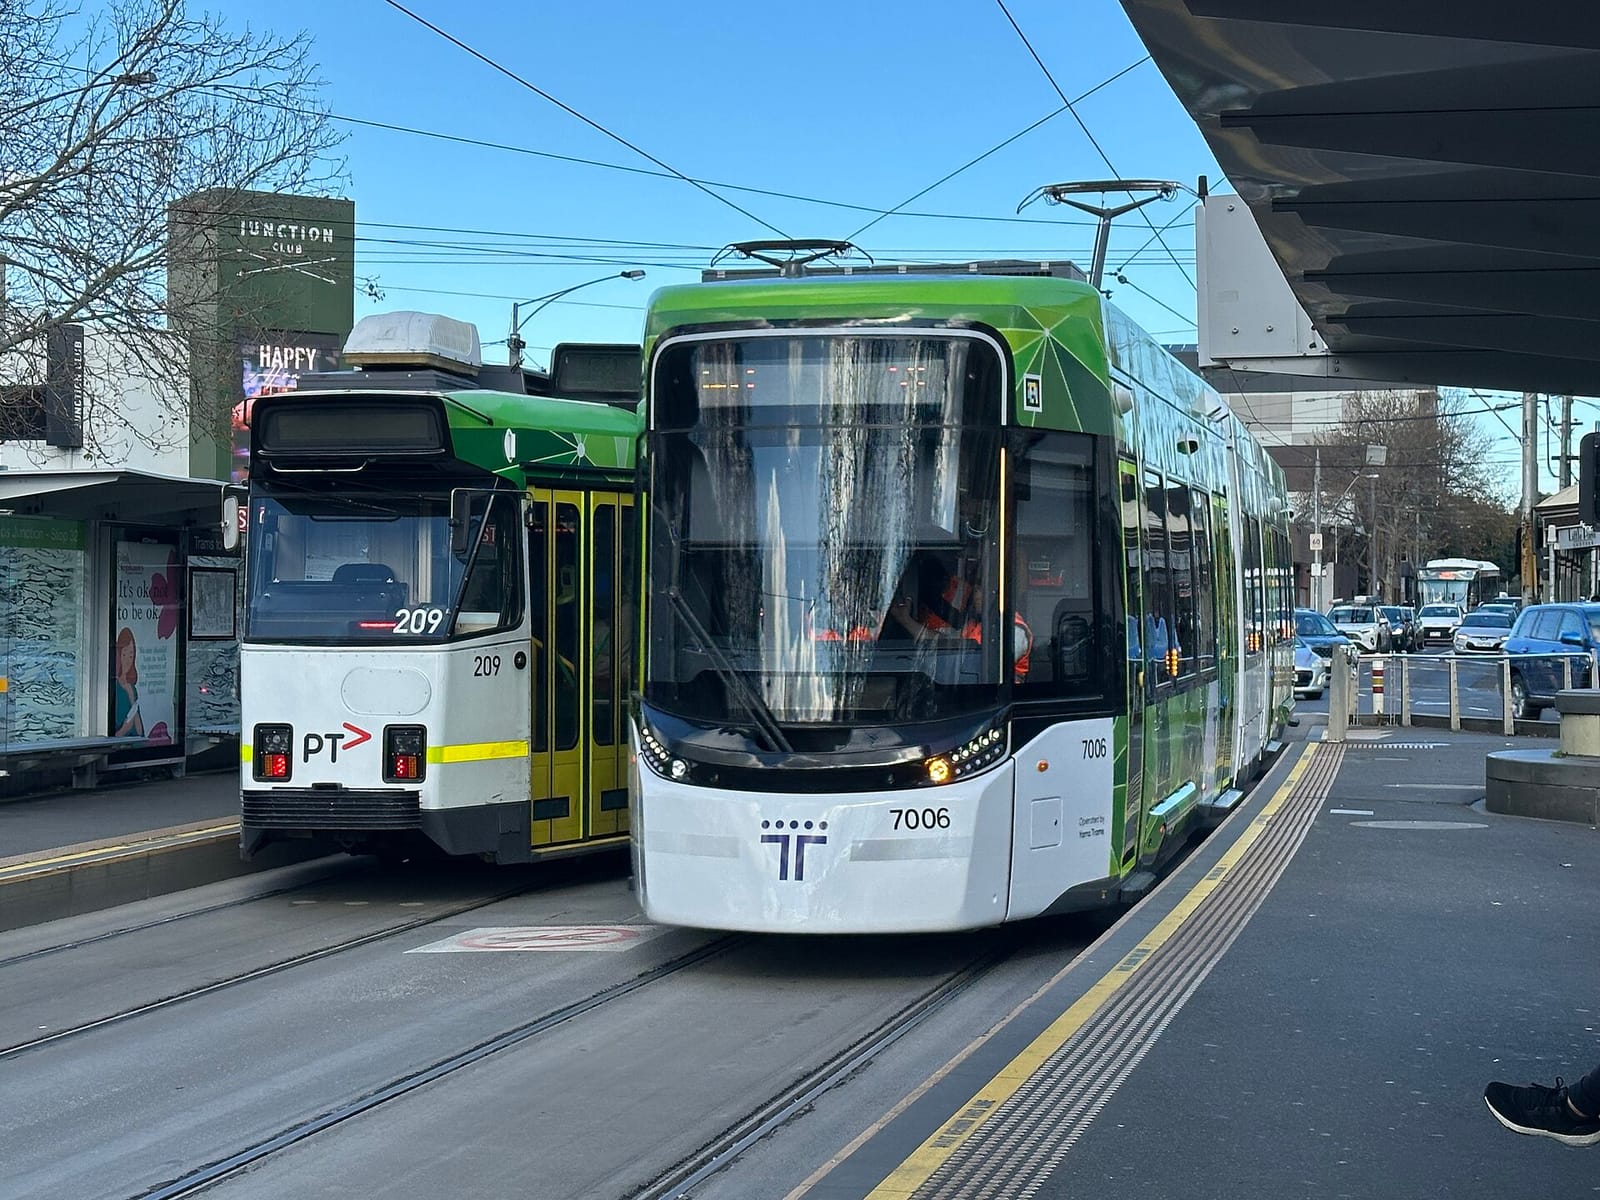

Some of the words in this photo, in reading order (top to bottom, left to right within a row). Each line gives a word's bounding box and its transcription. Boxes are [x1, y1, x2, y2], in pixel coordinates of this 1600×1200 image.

[240, 220, 333, 243] JUNCTION
[272, 241, 303, 254] CLUB
[260, 345, 317, 370] HAPPY
[119, 580, 134, 598] It's
[136, 580, 150, 598] ok
[117, 606, 128, 620] to
[131, 602, 143, 619] be
[393, 609, 443, 634] 209
[474, 656, 501, 676] 209
[1082, 738, 1106, 760] 7006
[889, 807, 950, 830] 7006
